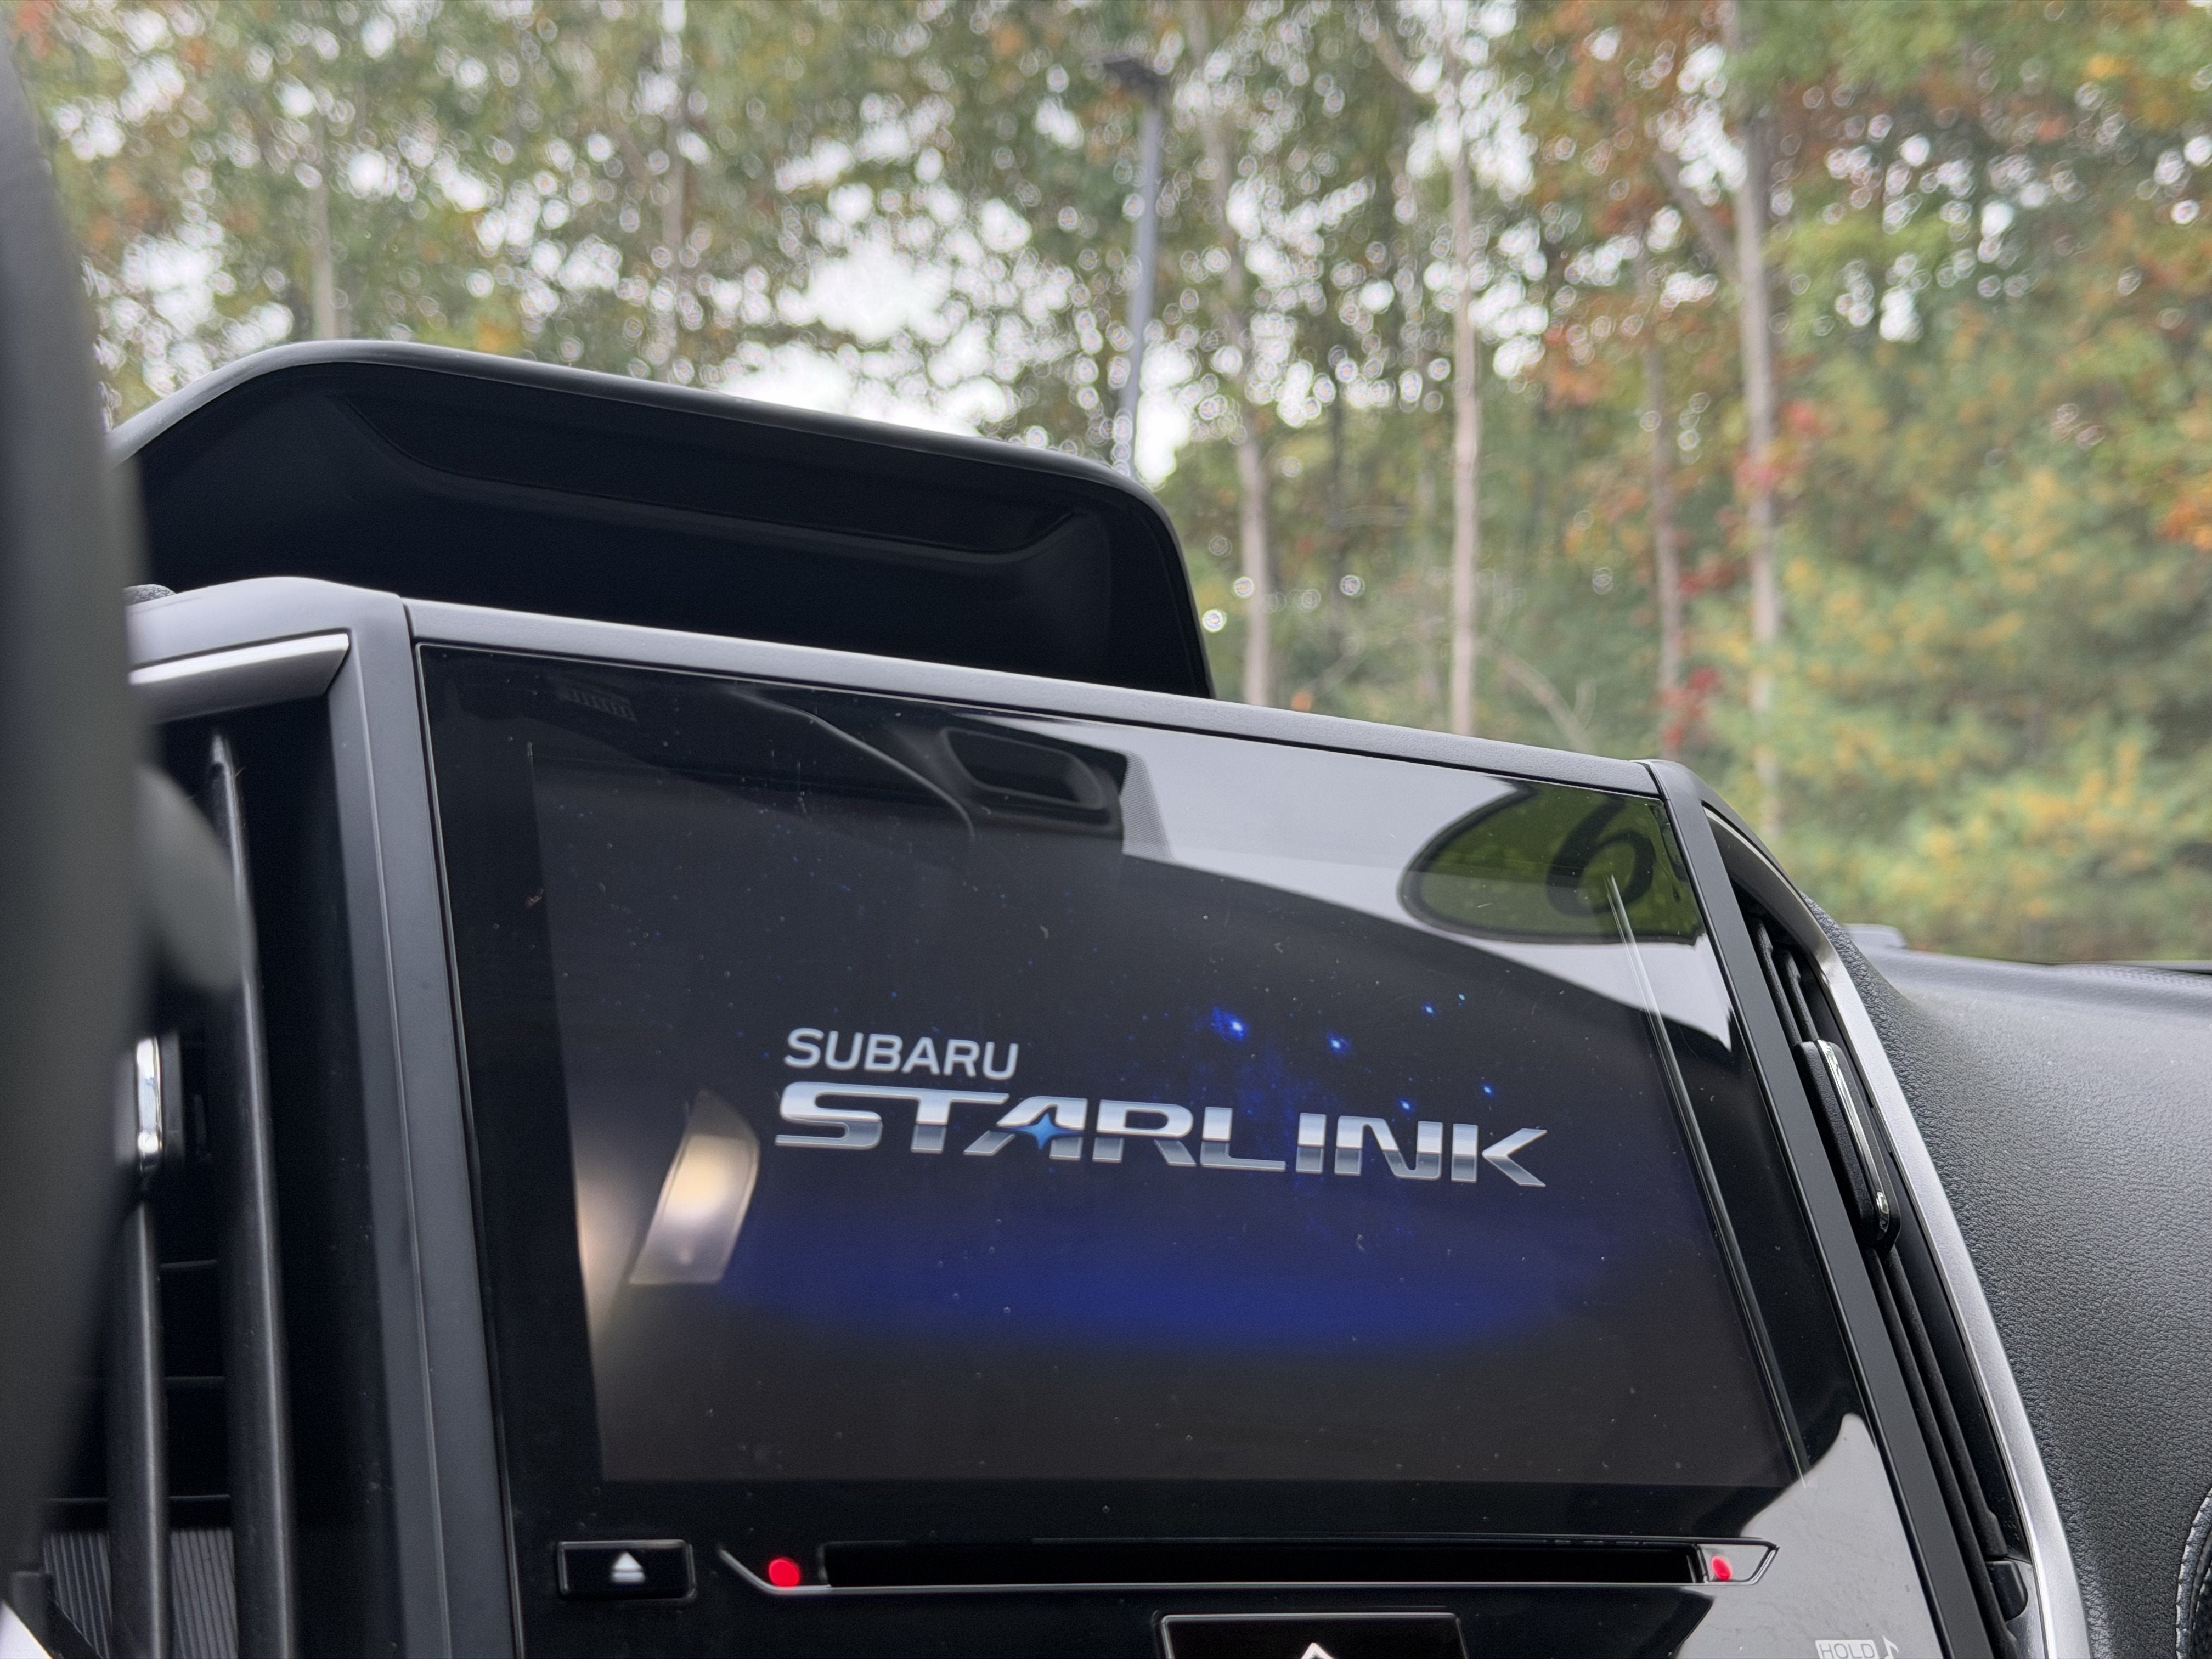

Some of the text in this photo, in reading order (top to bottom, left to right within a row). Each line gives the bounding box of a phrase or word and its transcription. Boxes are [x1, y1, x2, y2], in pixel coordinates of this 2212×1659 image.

[784, 1027, 1019, 1080] SUBARU
[775, 1081, 1547, 1187] STARLINK
[1820, 1643, 1875, 1659] HOLD
